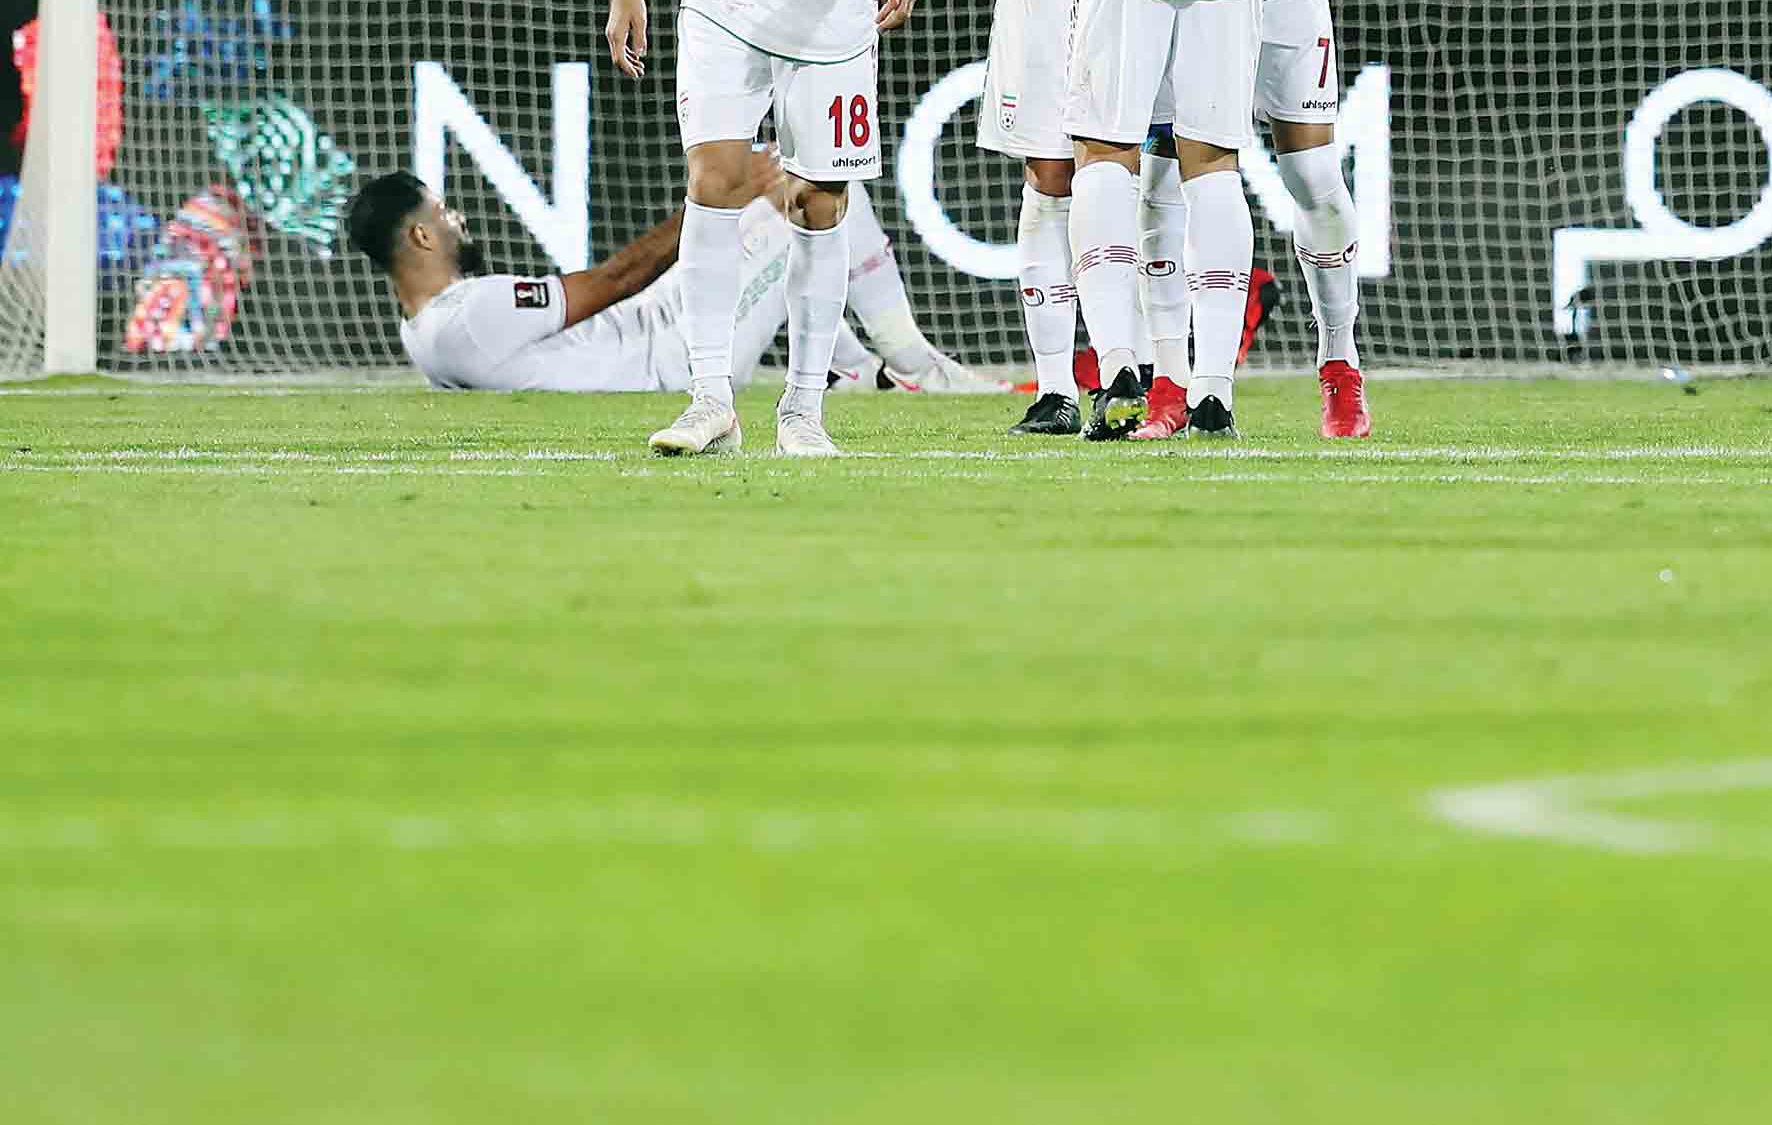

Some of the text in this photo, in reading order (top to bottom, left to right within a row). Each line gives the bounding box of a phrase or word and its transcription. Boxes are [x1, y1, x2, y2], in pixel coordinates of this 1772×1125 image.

[1317, 37, 1330, 89] 7
[828, 94, 870, 148] 18
[832, 155, 876, 168] uhlsport
